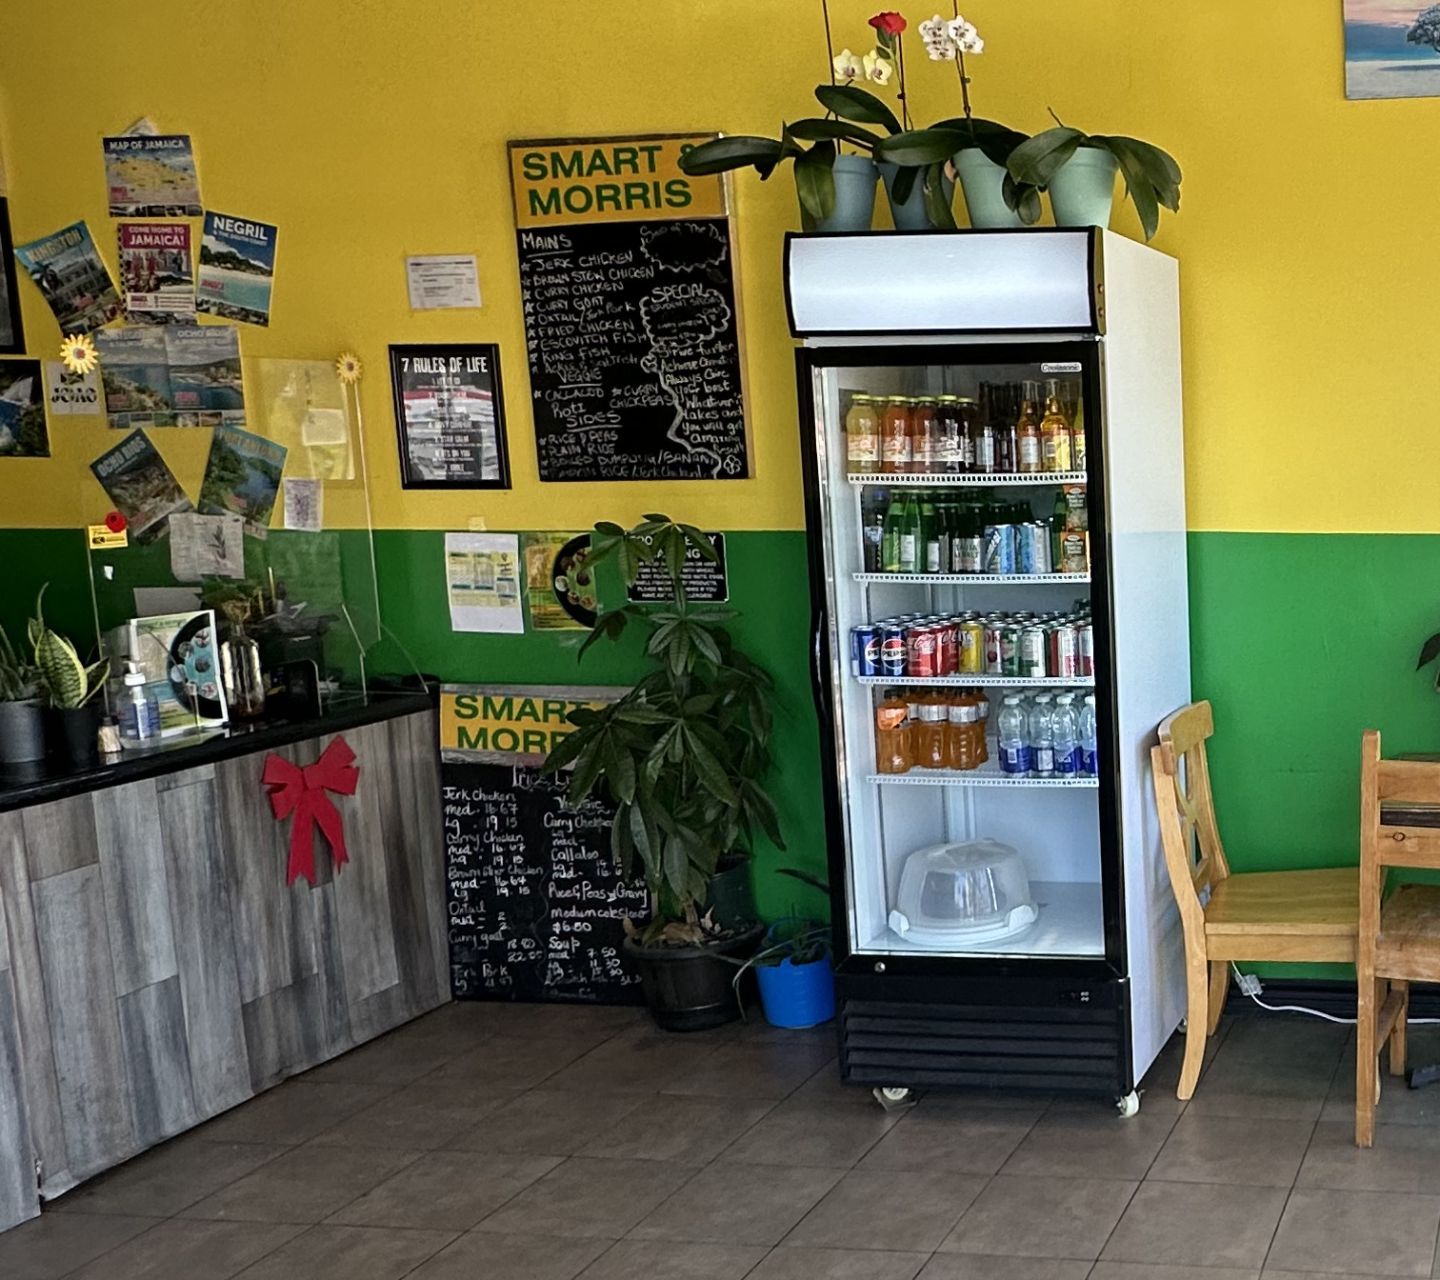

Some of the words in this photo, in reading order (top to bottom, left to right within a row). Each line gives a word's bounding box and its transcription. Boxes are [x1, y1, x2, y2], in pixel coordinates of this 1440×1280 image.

[109, 140, 129, 149] MAP
[131, 141, 142, 149] OF
[145, 139, 185, 149] JAMAICA
[522, 145, 662, 181] SMART
[528, 179, 692, 216] MORRIS
[128, 226, 149, 234] COME
[151, 226, 172, 234] HOME
[174, 226, 185, 234] TO
[213, 216, 269, 240] NEGRIL
[129, 234, 185, 246] JAMAICA!
[521, 231, 572, 250] MAINS
[532, 258, 574, 272] JERK
[579, 250, 633, 268] CHICKEN
[534, 286, 569, 300] CURRY
[571, 281, 624, 296] CHICKEN
[651, 282, 710, 303] SPECIAL
[536, 299, 569, 313] CURRY
[573, 296, 604, 310] GOAT
[177, 329, 203, 338] OCHO
[538, 325, 576, 337] FRIED
[578, 319, 635, 333] CHICKEN
[542, 351, 575, 364] KING
[579, 346, 611, 361] FISH
[401, 357, 409, 372] 7
[413, 357, 446, 373] RULES
[449, 357, 462, 372] OF
[466, 356, 488, 372] LIFE
[556, 368, 602, 384] VEGGIE
[566, 411, 621, 428] SIDES
[548, 433, 577, 445] RICE
[443, 787, 470, 800] Jerk
[543, 811, 573, 833] Curry
[549, 936, 580, 954] Soup
